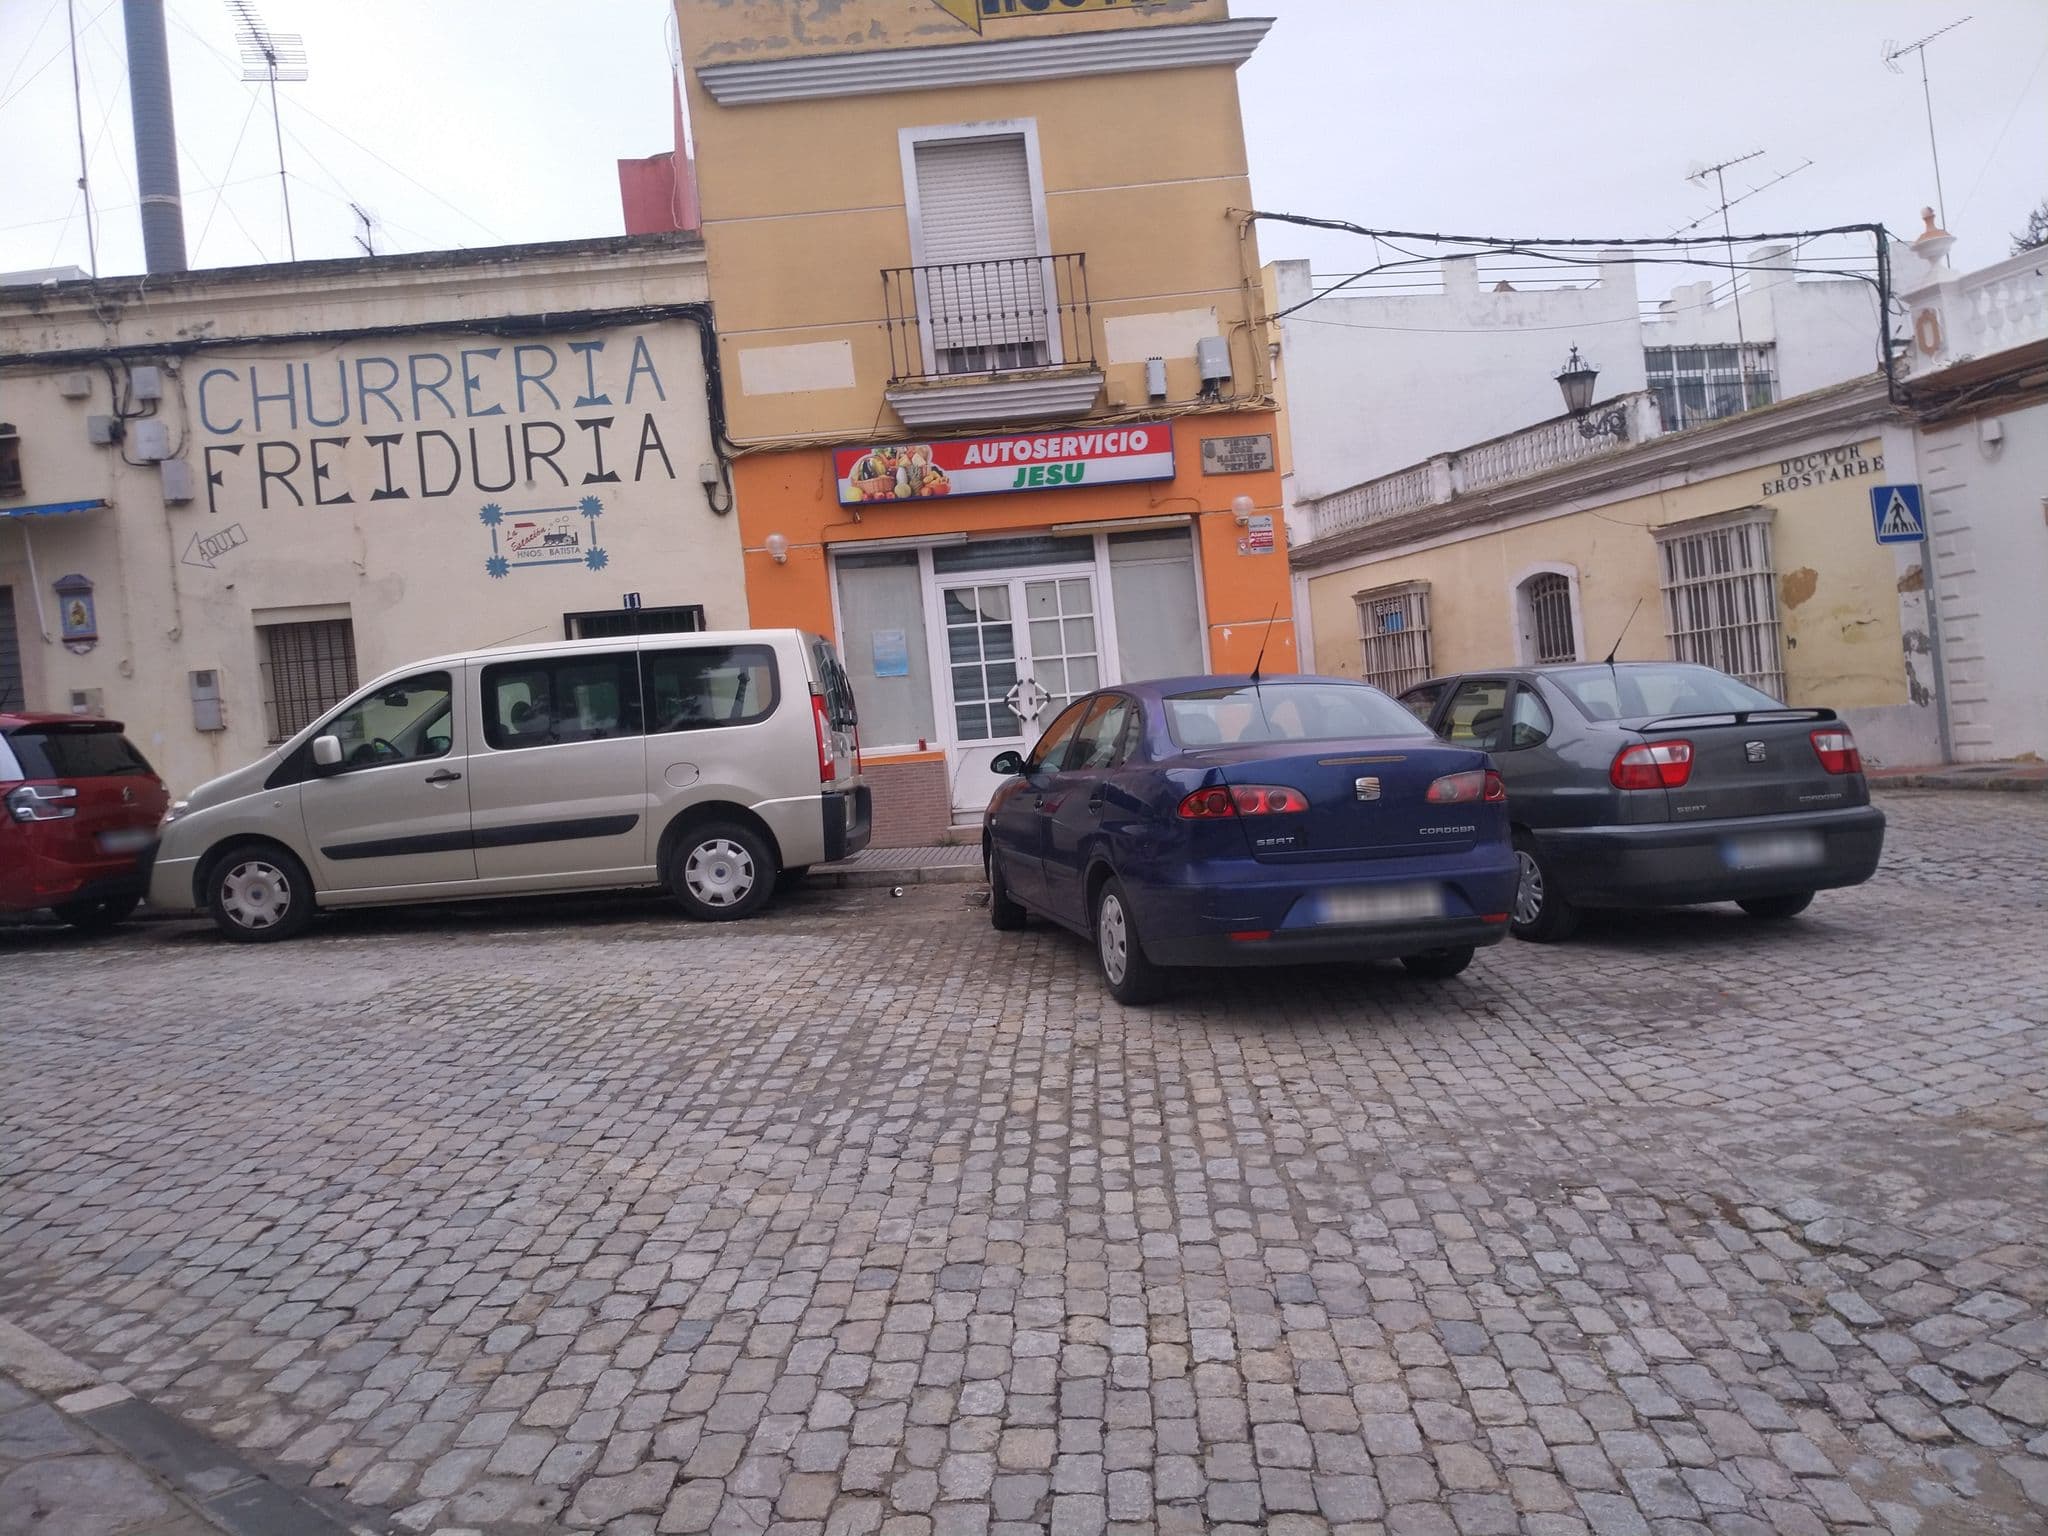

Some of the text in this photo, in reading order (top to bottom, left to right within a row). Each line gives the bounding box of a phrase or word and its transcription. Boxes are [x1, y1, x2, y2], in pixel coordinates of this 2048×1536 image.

[199, 335, 667, 436] CHURRERIA
[963, 430, 1149, 466] AUTOSERVICIO
[1780, 445, 1861, 476] DOCTOR
[204, 412, 676, 514] FREIDURIA
[1012, 462, 1086, 488] JESU
[1761, 456, 1886, 496] EROSTARBE
[549, 547, 581, 556] BATISTA
[624, 593, 641, 609] 11
[1256, 836, 1295, 847] SEAT
[1419, 825, 1476, 835] CORDOBA
